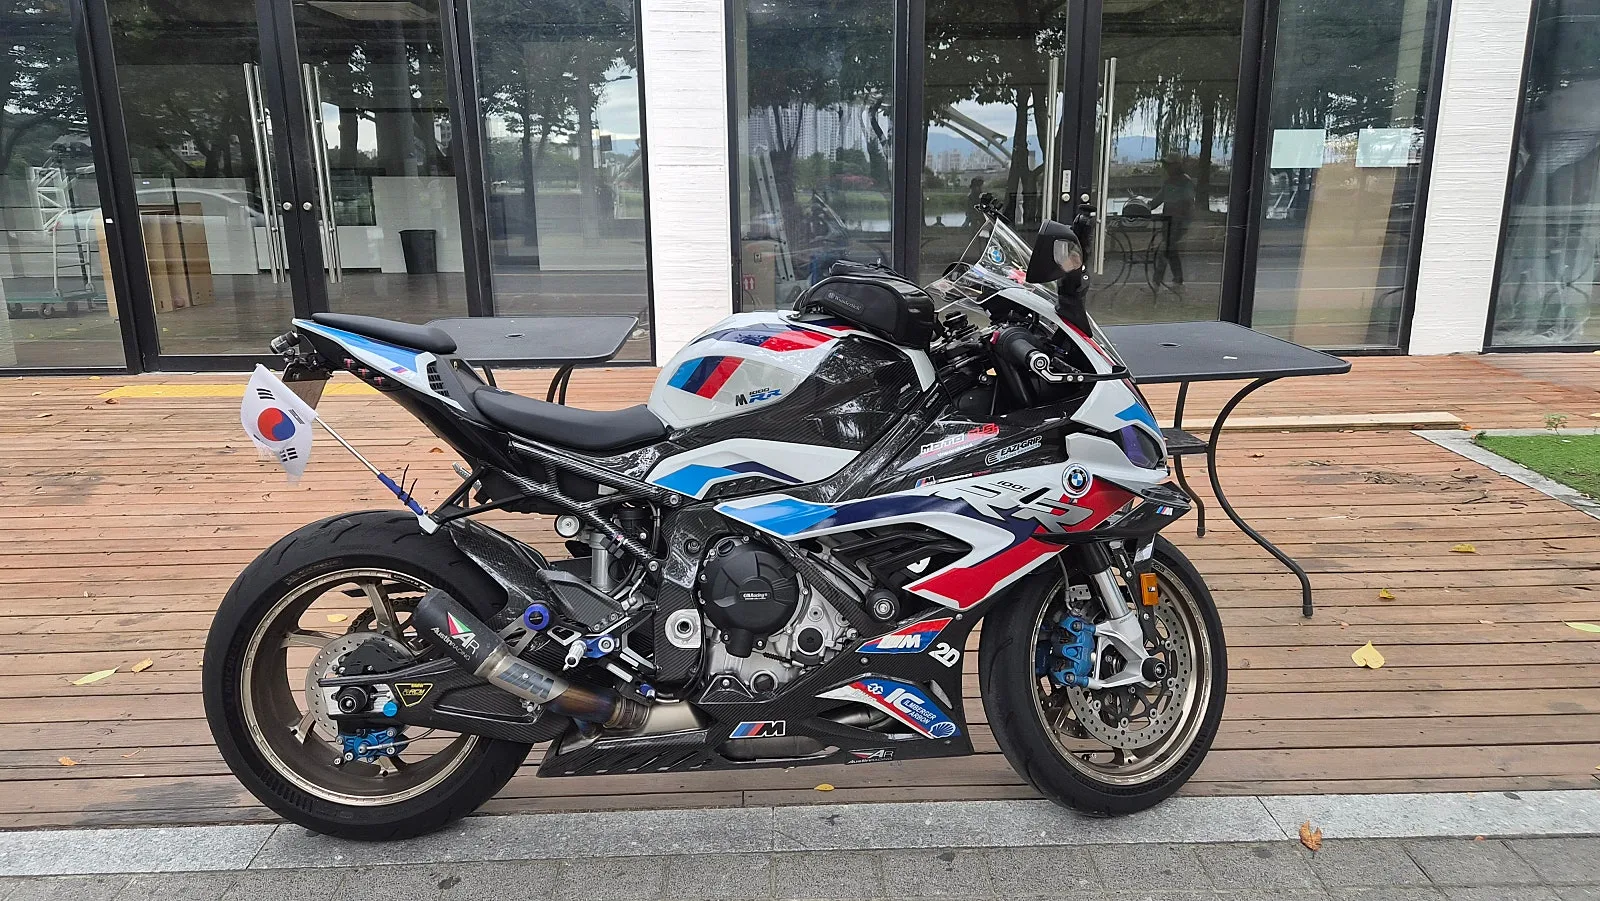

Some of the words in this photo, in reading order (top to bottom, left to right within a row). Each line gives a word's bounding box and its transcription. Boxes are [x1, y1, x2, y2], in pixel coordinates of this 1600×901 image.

[735, 393, 748, 407] M
[748, 389, 782, 404] RR
[749, 387, 770, 395] 1000
[902, 699, 937, 721] ILMBERGER
